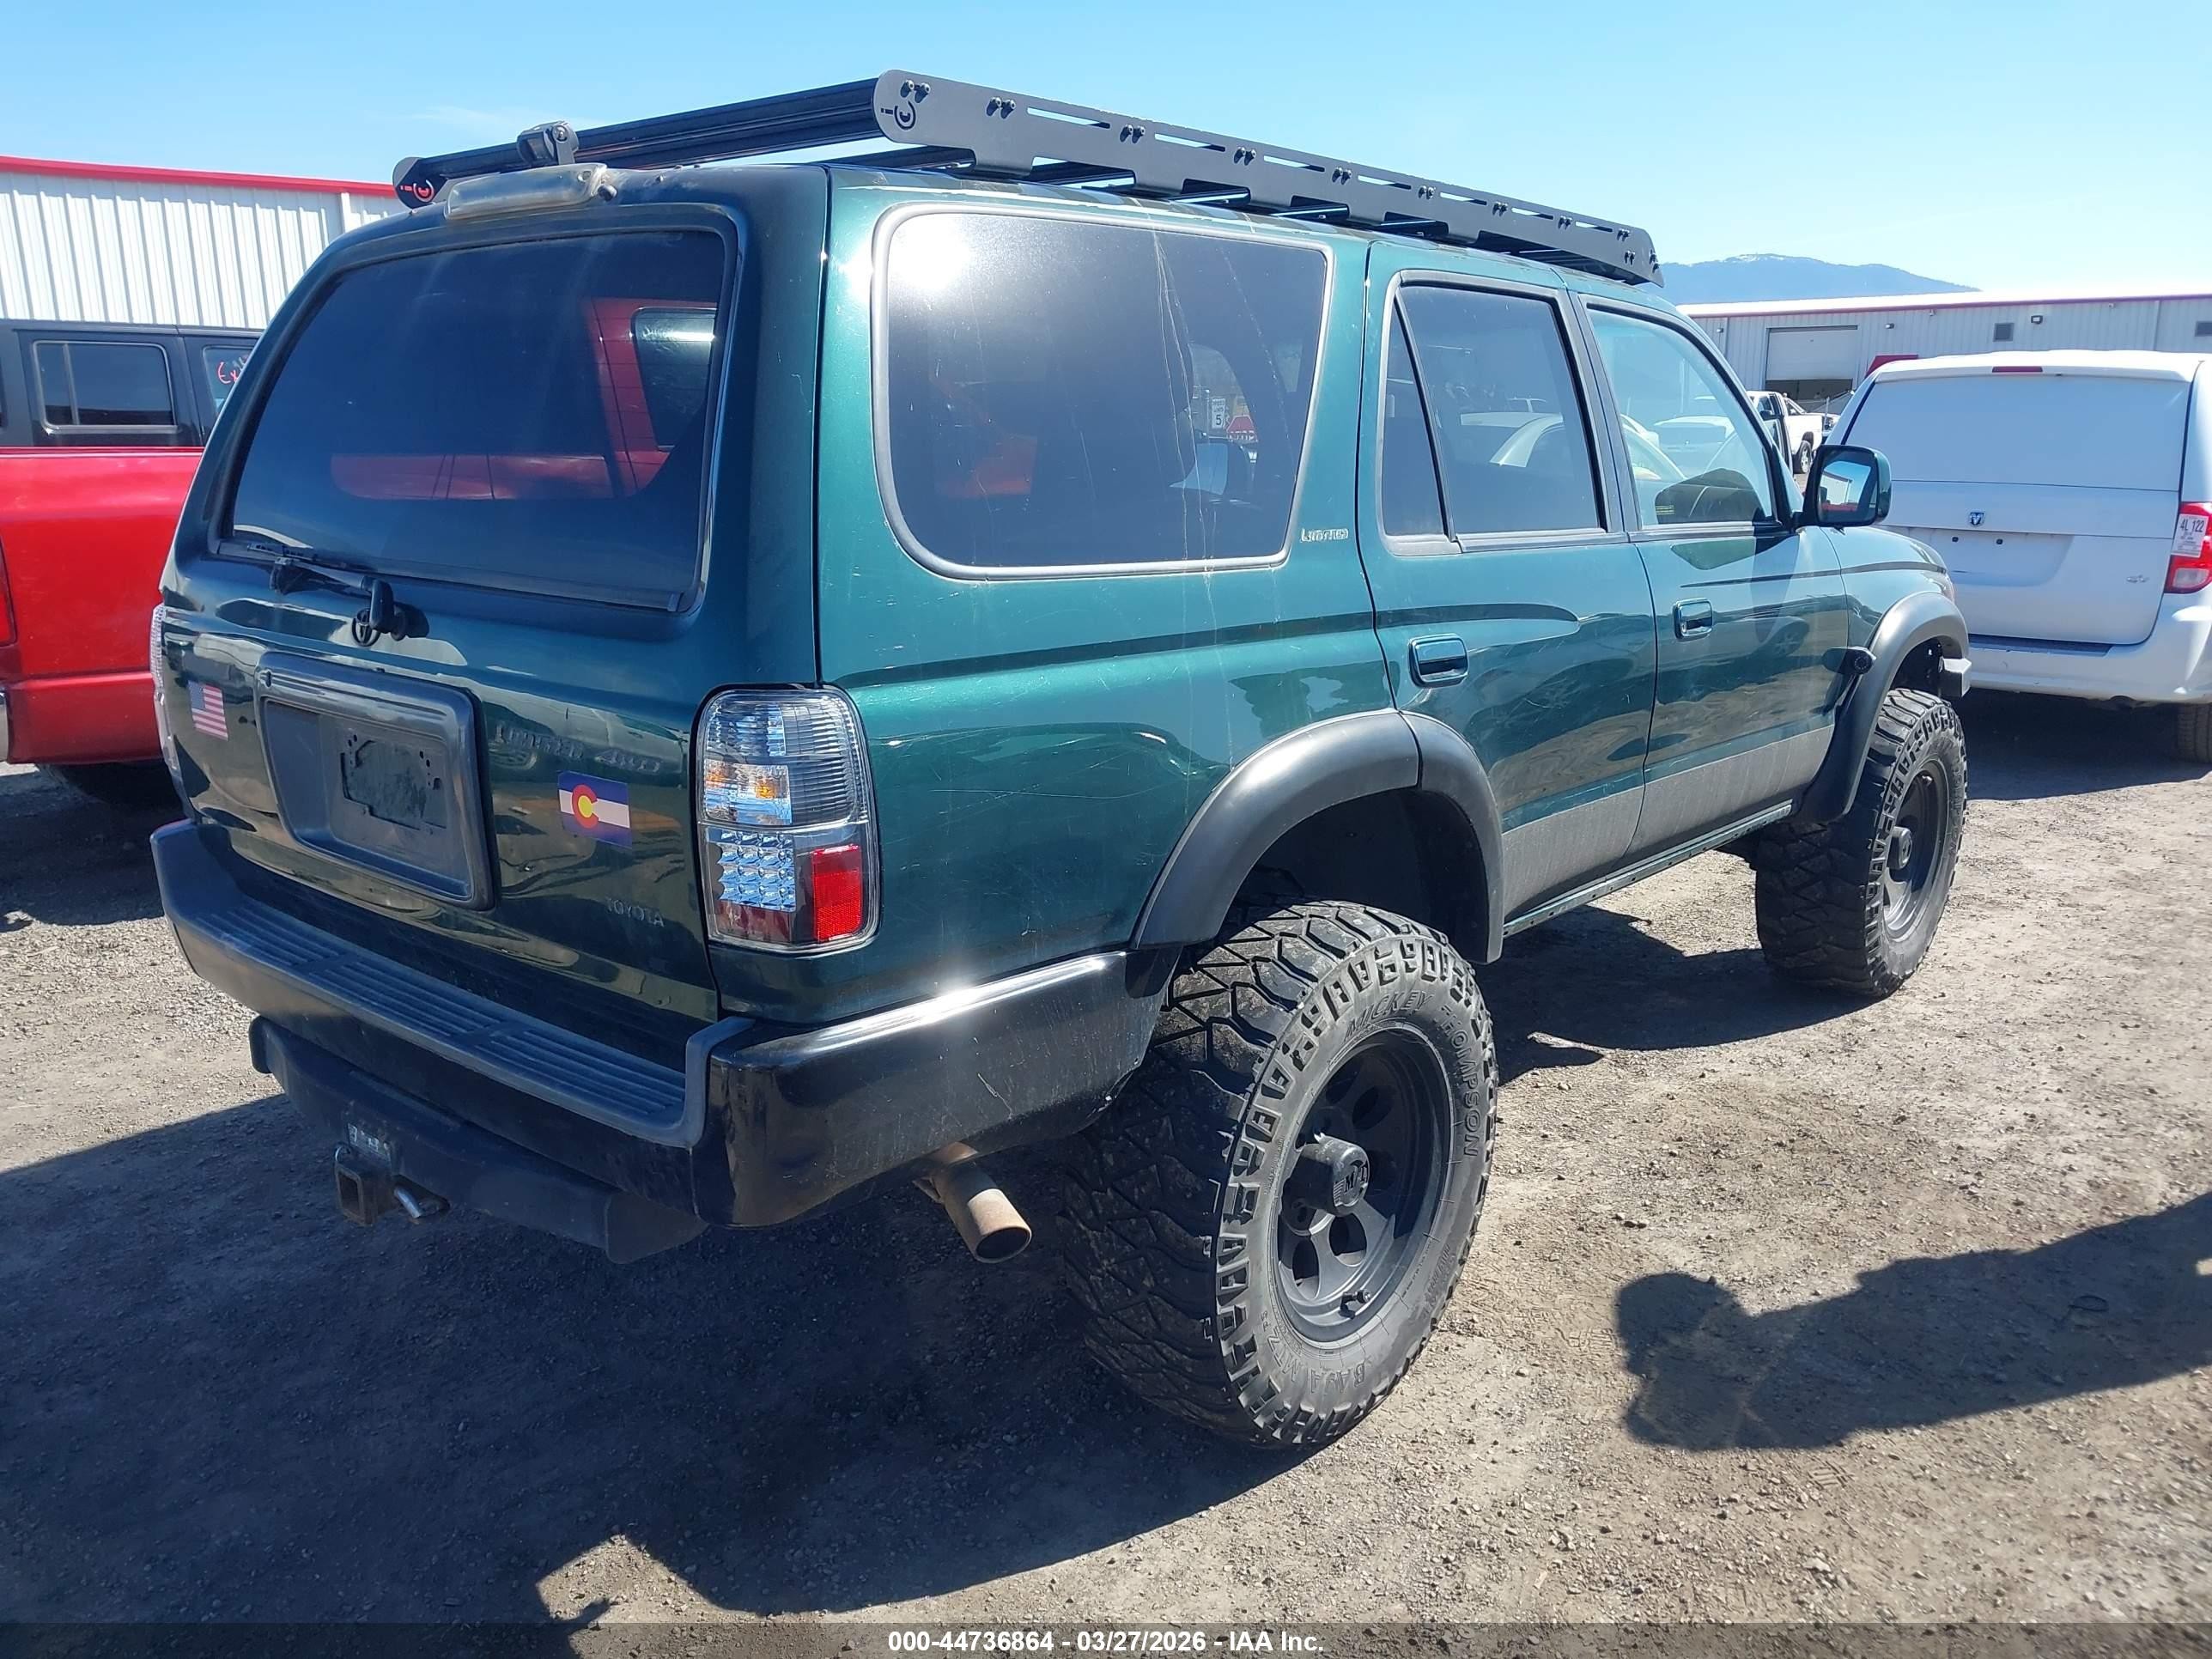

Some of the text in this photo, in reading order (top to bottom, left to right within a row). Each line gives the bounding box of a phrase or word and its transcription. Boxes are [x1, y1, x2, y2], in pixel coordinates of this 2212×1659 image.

[1215, 414, 1222, 426] 5
[2180, 518, 2204, 532] 4L 122
[605, 896, 665, 928] TOYOTA
[1345, 988, 1481, 1158] MICKEY THOMPSON
[1306, 1357, 1365, 1395] BAJA
